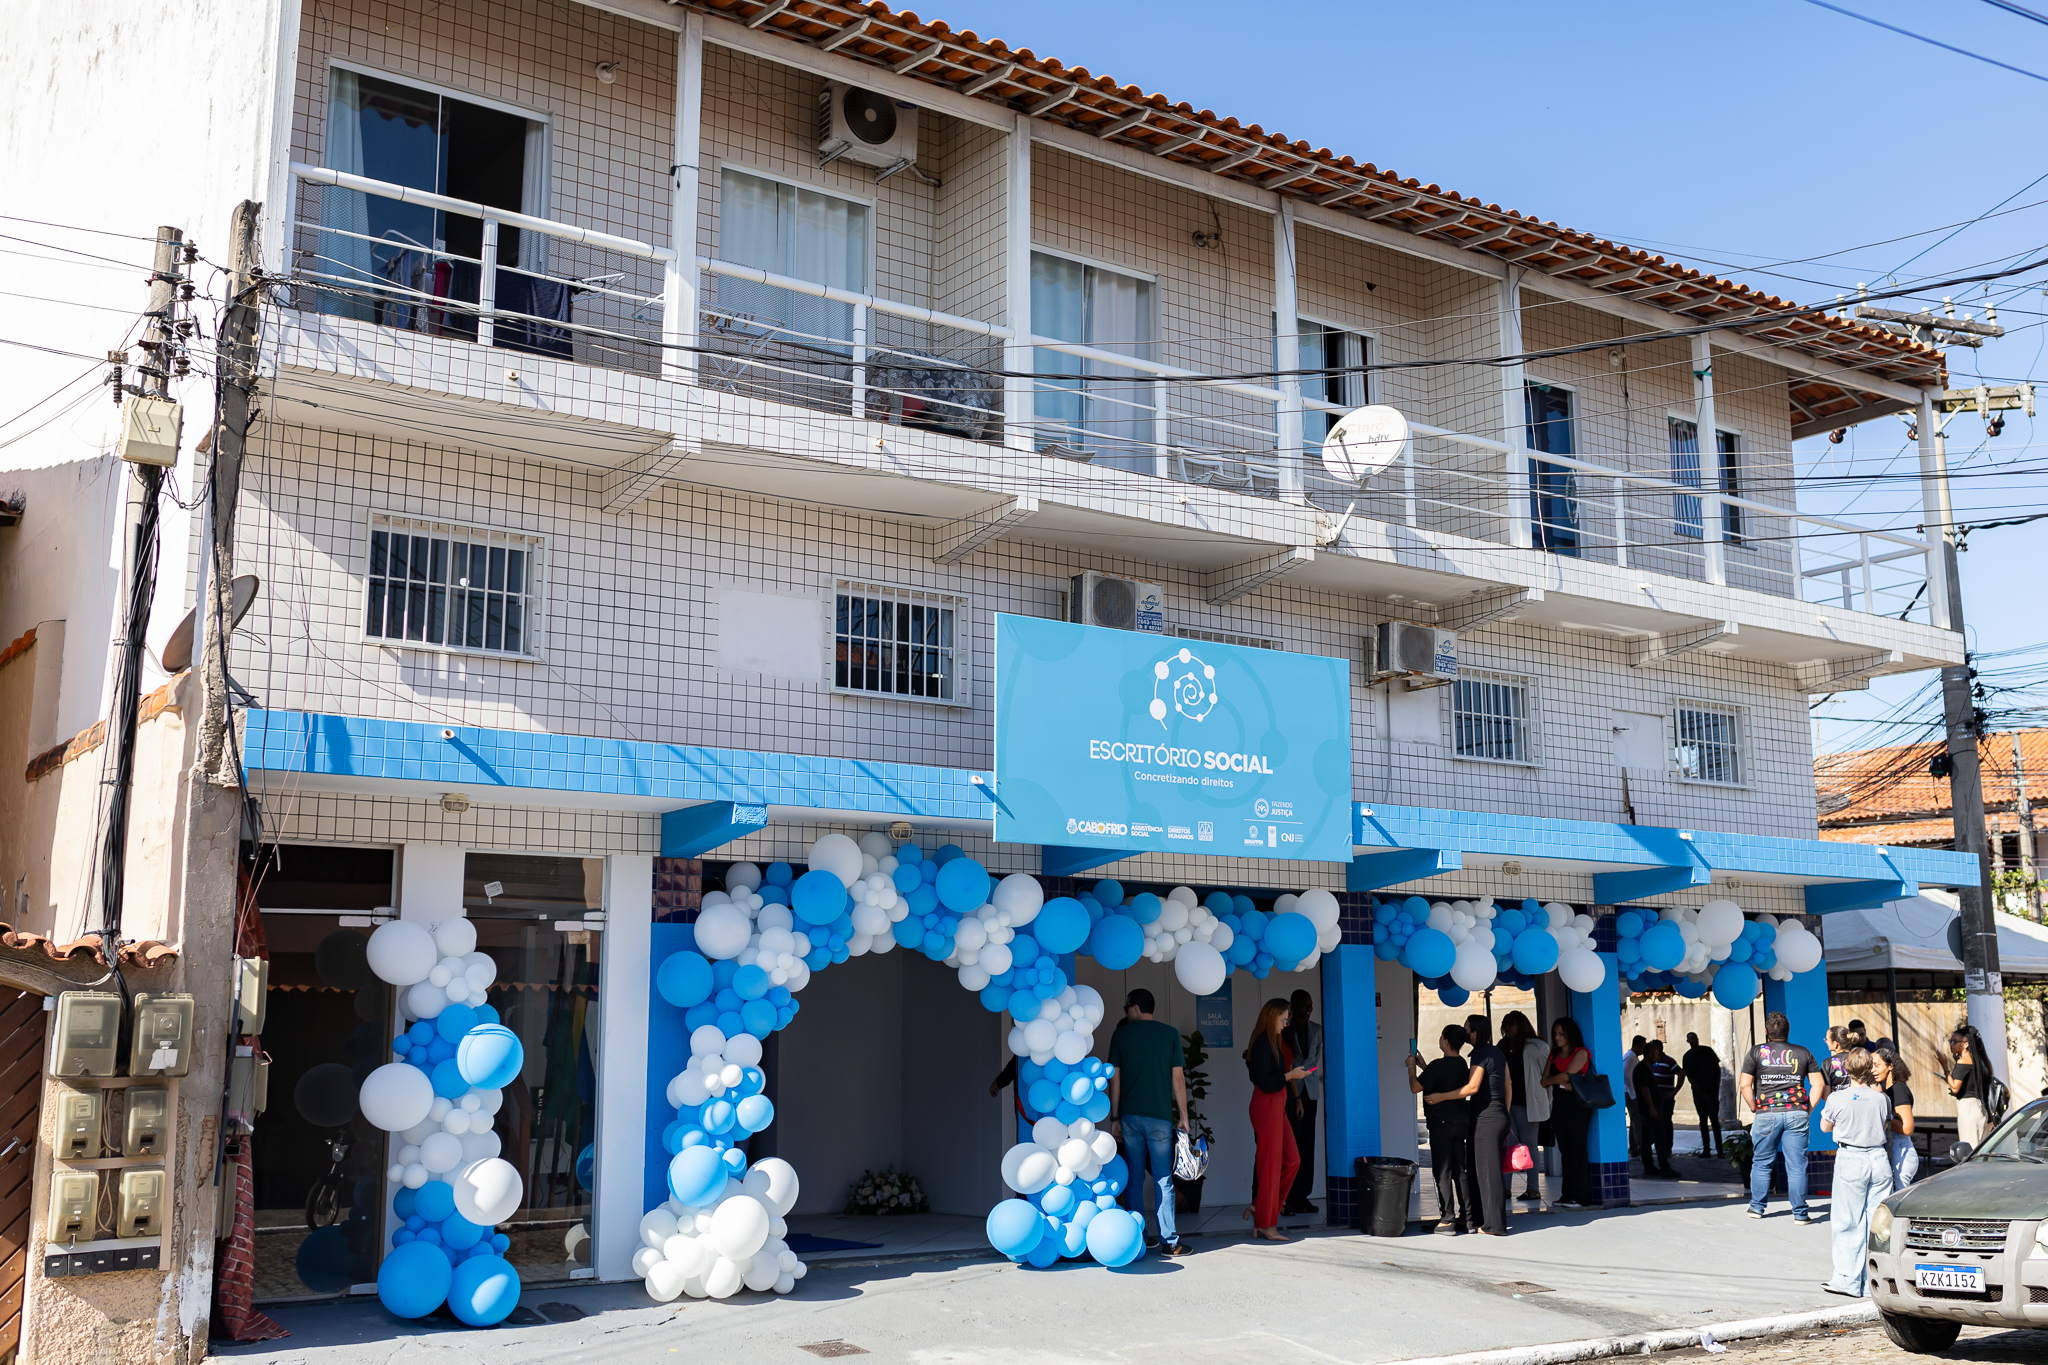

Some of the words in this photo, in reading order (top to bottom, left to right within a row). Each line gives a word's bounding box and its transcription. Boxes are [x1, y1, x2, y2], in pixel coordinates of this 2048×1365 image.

[1346, 422, 1385, 434] Claro
[1090, 739, 1201, 768] ESCRITÓRIO
[1203, 750, 1274, 775] SOCIAL
[1134, 770, 1199, 785] Concretizando
[1201, 776, 1234, 788] direitos
[1271, 801, 1293, 809] FAZENDO
[1270, 808, 1294, 818] JUSTIÇA
[1130, 824, 1164, 833] ASSISTÊNCIA
[1766, 1049, 1799, 1075] Kelly
[1921, 1272, 1976, 1288] KZK1I52
